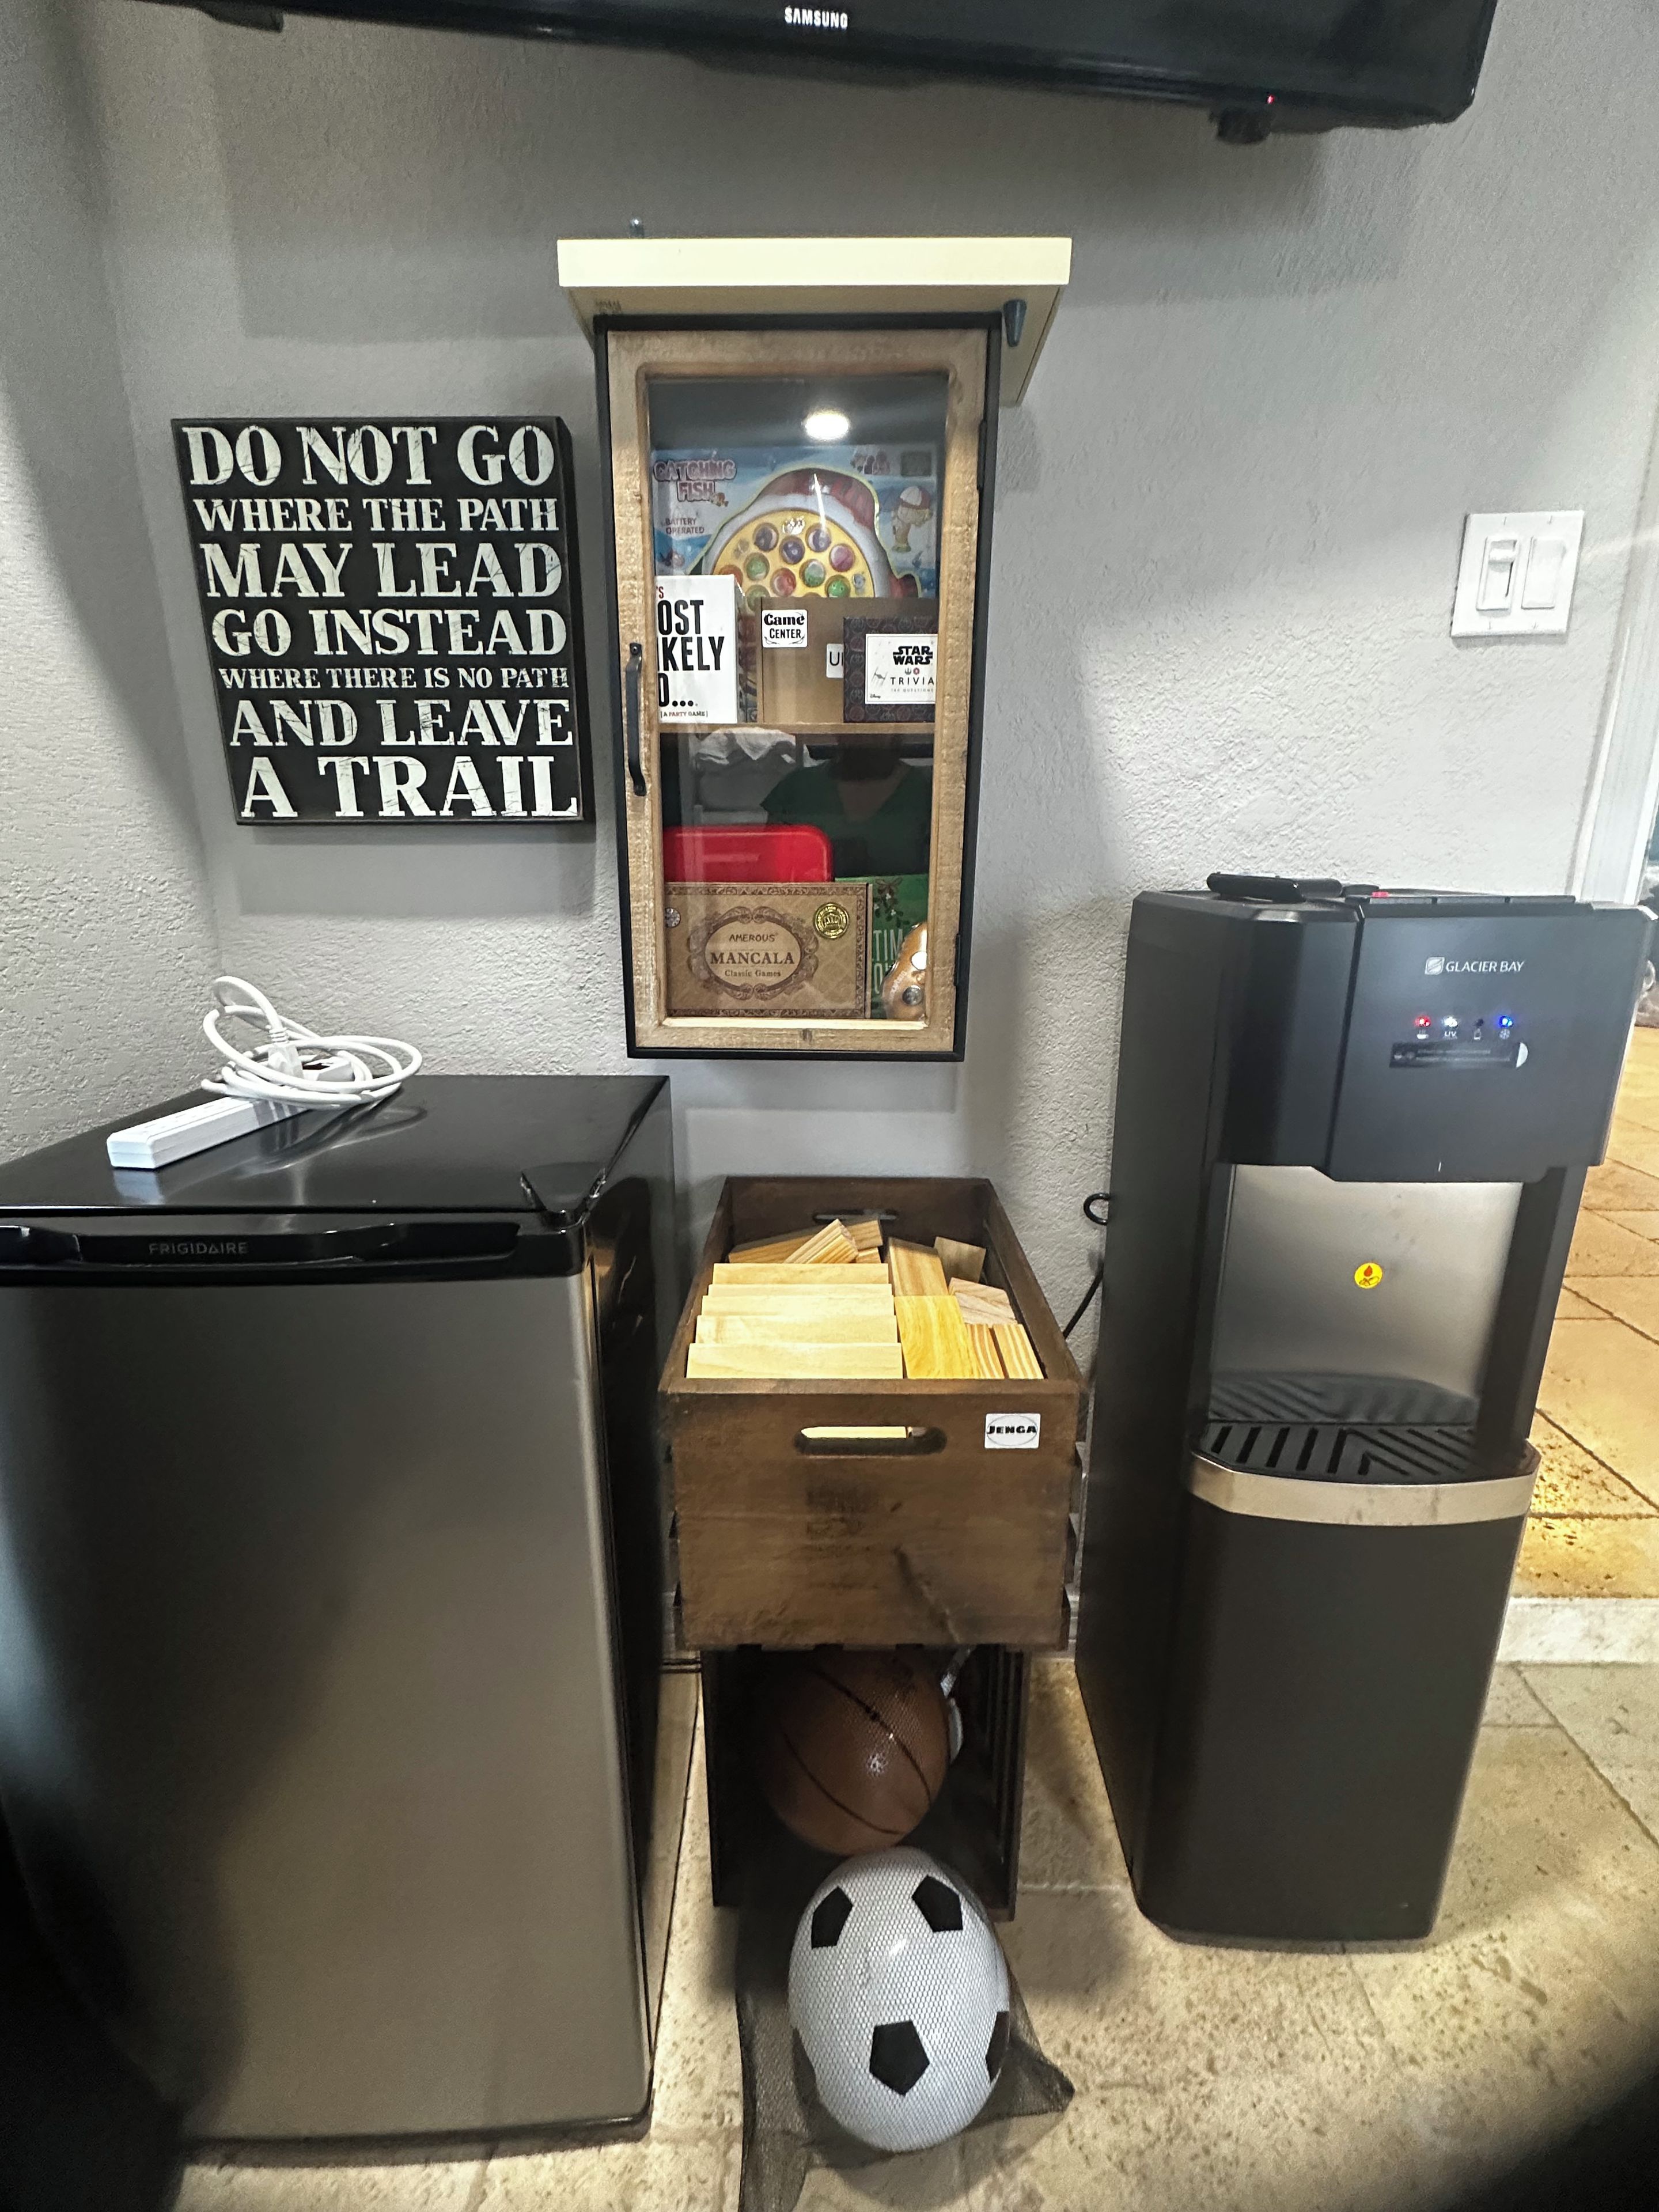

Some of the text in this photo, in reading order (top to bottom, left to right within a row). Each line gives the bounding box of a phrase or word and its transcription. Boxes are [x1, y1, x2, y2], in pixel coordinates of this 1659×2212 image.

[785, 5, 848, 29] SAMSUNG
[182, 425, 554, 486] DO NOT GO
[677, 480, 715, 502] FISH
[193, 498, 559, 532] WHERE THE PATH
[666, 527, 704, 535] OPERATED
[199, 543, 562, 597] MAY LEAD
[657, 600, 704, 635] OST
[764, 613, 805, 626] Game
[212, 609, 567, 657] GO INSTEAD
[770, 628, 801, 639] CENTER
[893, 646, 933, 656] STAR
[893, 656, 933, 665] WARS
[219, 667, 569, 689] WHERE THERE IS NO PATH
[890, 677, 934, 685] TRIVIA
[229, 699, 573, 747] AND LEAVE
[241, 756, 578, 817] A TRAIL
[710, 952, 794, 964] MANCALA
[1445, 960, 1525, 973] GLACIER BAY
[149, 1242, 249, 1255] FRIGIDAIRE
[986, 1426, 1037, 1434] JENGA
